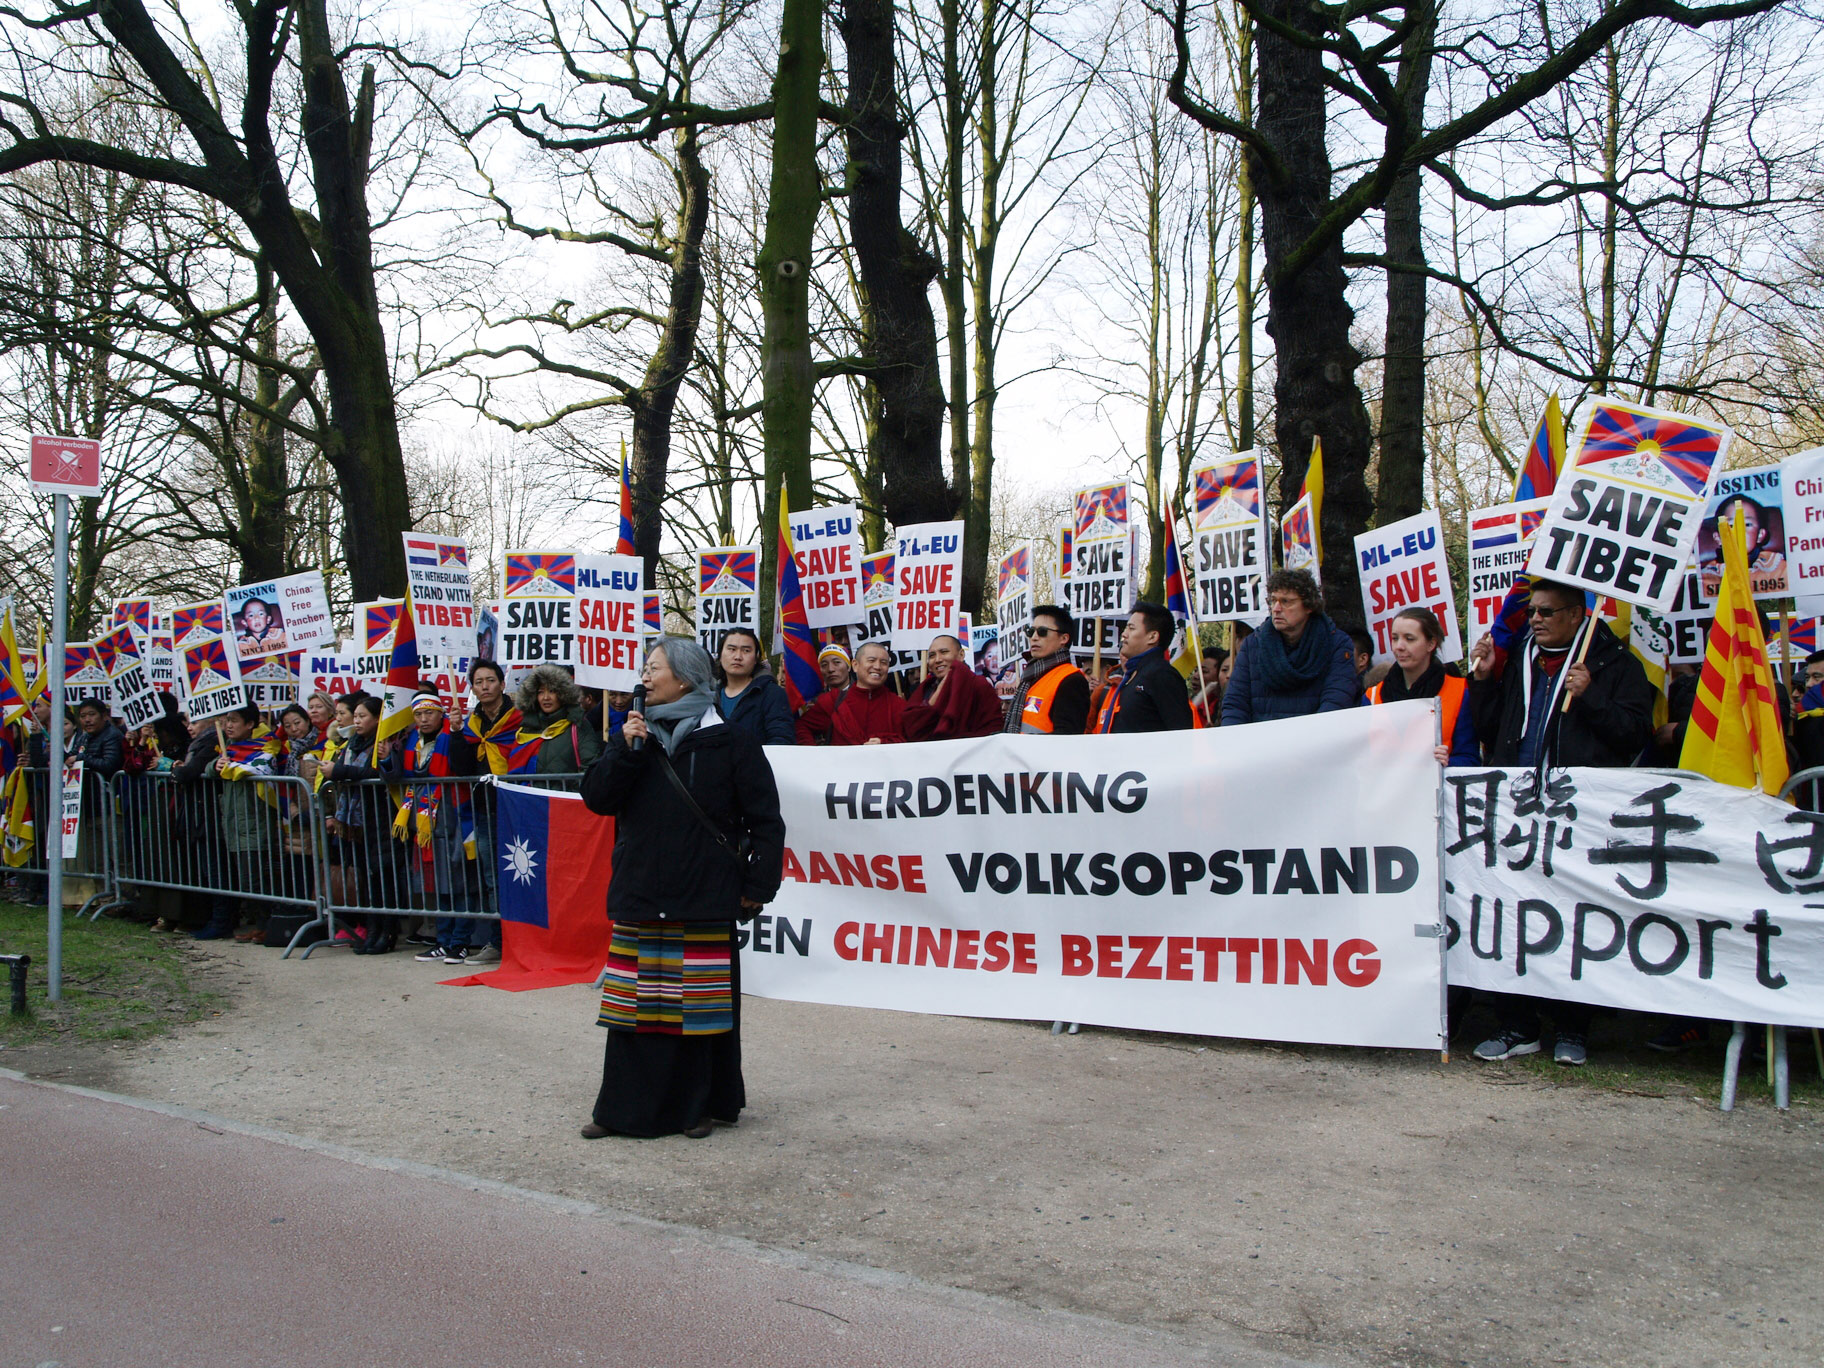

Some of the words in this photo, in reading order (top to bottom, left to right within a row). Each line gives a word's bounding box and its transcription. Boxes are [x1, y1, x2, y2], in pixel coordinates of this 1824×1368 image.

[37, 439, 62, 447] alcohol
[63, 441, 94, 450] verboden
[1714, 471, 1779, 497] ISSING
[1795, 477, 1823, 496] Chi
[1562, 479, 1688, 547] SAVE
[899, 535, 958, 558] NL-EU
[1077, 541, 1124, 577] SAVE
[1199, 528, 1257, 572] SAVE
[1361, 526, 1436, 572] NL-EU
[410, 569, 424, 581] THE
[424, 571, 470, 584] NETHERLANDS
[794, 545, 853, 579] SAVE
[1472, 555, 1491, 570] THE
[1544, 526, 1678, 600] TIBET
[229, 584, 276, 601] MISSING
[285, 585, 313, 597] China:
[413, 585, 443, 600] STAND
[445, 588, 471, 602] WITH
[577, 568, 638, 591] NL-EU
[800, 577, 857, 610] IBET
[900, 564, 953, 596] SAVE
[1199, 573, 1262, 615] TIBET
[1369, 561, 1440, 615] SAVE
[1752, 577, 1786, 592] 1995
[291, 601, 311, 611] Free
[1073, 578, 1126, 613] TIBET
[286, 613, 325, 627] Panchen
[415, 603, 473, 628] TIBET
[507, 601, 571, 628] SAVE
[579, 598, 635, 633] SAVE
[702, 597, 752, 624] SAVE
[897, 599, 954, 630] TIBET
[999, 592, 1027, 632] SAVE
[241, 645, 265, 656] SINCE
[268, 641, 286, 651] 1995
[292, 630, 317, 641] Lama
[503, 634, 574, 660] TIBET
[973, 628, 998, 640] MISS
[577, 634, 638, 670] TIBET
[92, 687, 111, 701] TIB
[114, 667, 149, 701] SAVE
[122, 691, 160, 727] TIBET
[188, 695, 211, 717] SAVE
[211, 686, 242, 710] TIBET
[826, 770, 1148, 821] HERDENKING
[781, 847, 927, 893] AANSE
[946, 845, 1420, 896] VOLKSOPSTAND
[736, 915, 812, 957] GEN
[833, 921, 1038, 975] CHINESE
[1061, 934, 1382, 988] BEZETTING
